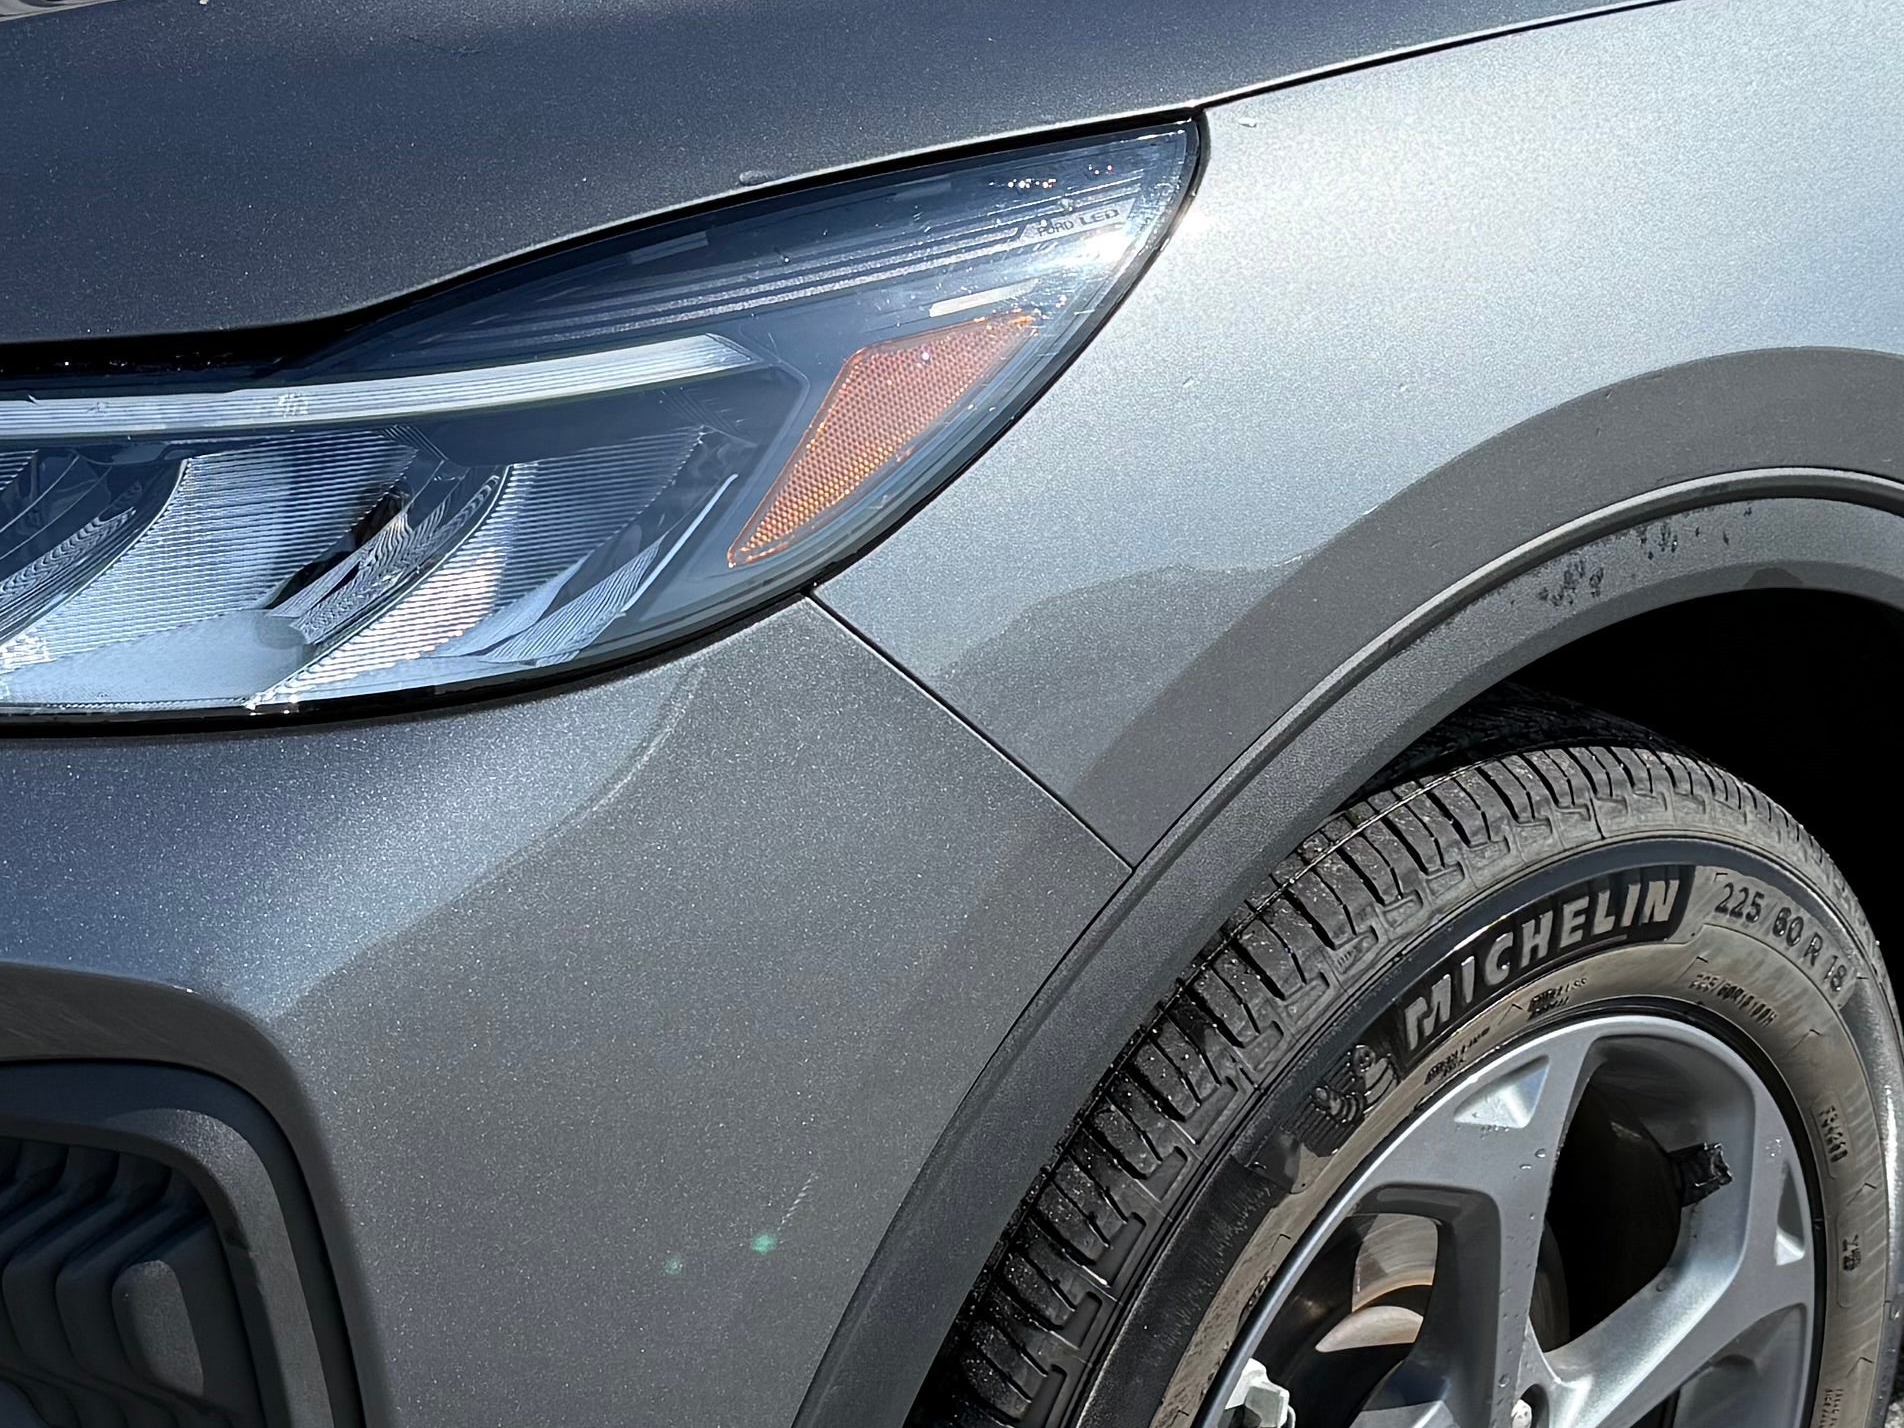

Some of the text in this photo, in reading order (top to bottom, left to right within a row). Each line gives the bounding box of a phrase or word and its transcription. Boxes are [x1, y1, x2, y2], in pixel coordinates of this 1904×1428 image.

[1038, 209, 1120, 236] FORD LED
[1404, 878, 1680, 1051] MICHELIN
